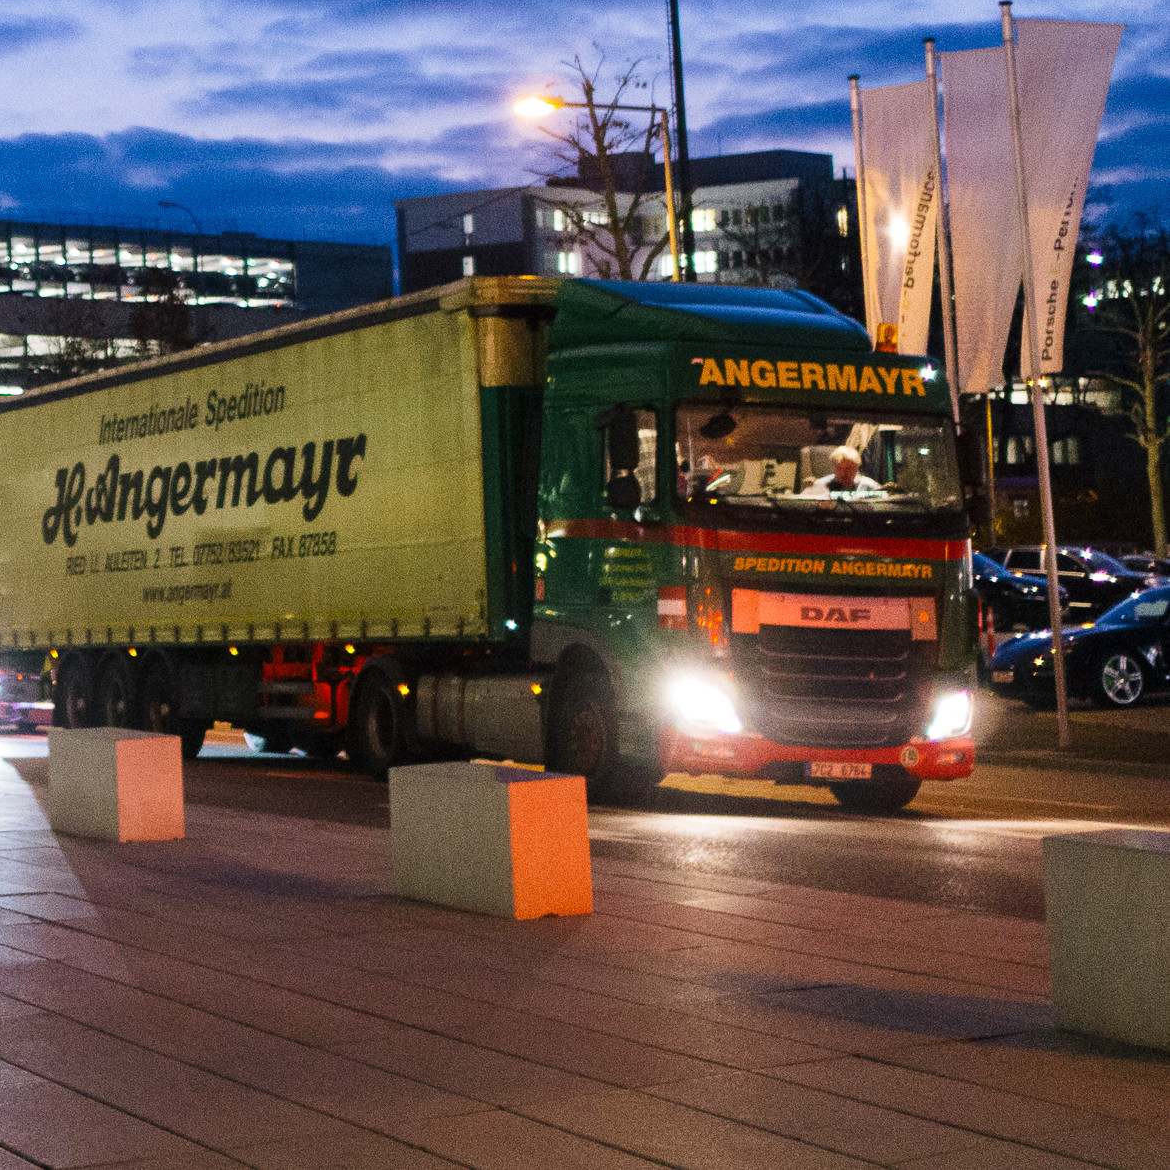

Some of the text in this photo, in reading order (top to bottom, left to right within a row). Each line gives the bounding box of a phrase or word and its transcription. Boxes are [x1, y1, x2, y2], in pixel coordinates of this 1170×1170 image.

[1040, 279, 1060, 361] Porsche
[699, 358, 926, 396] ANGERMAYR
[98, 382, 286, 446] Internationale Spedition
[271, 536, 294, 560] FAX
[733, 556, 932, 580] SPEDITION ANGERMAYR
[800, 606, 871, 623] DAF
